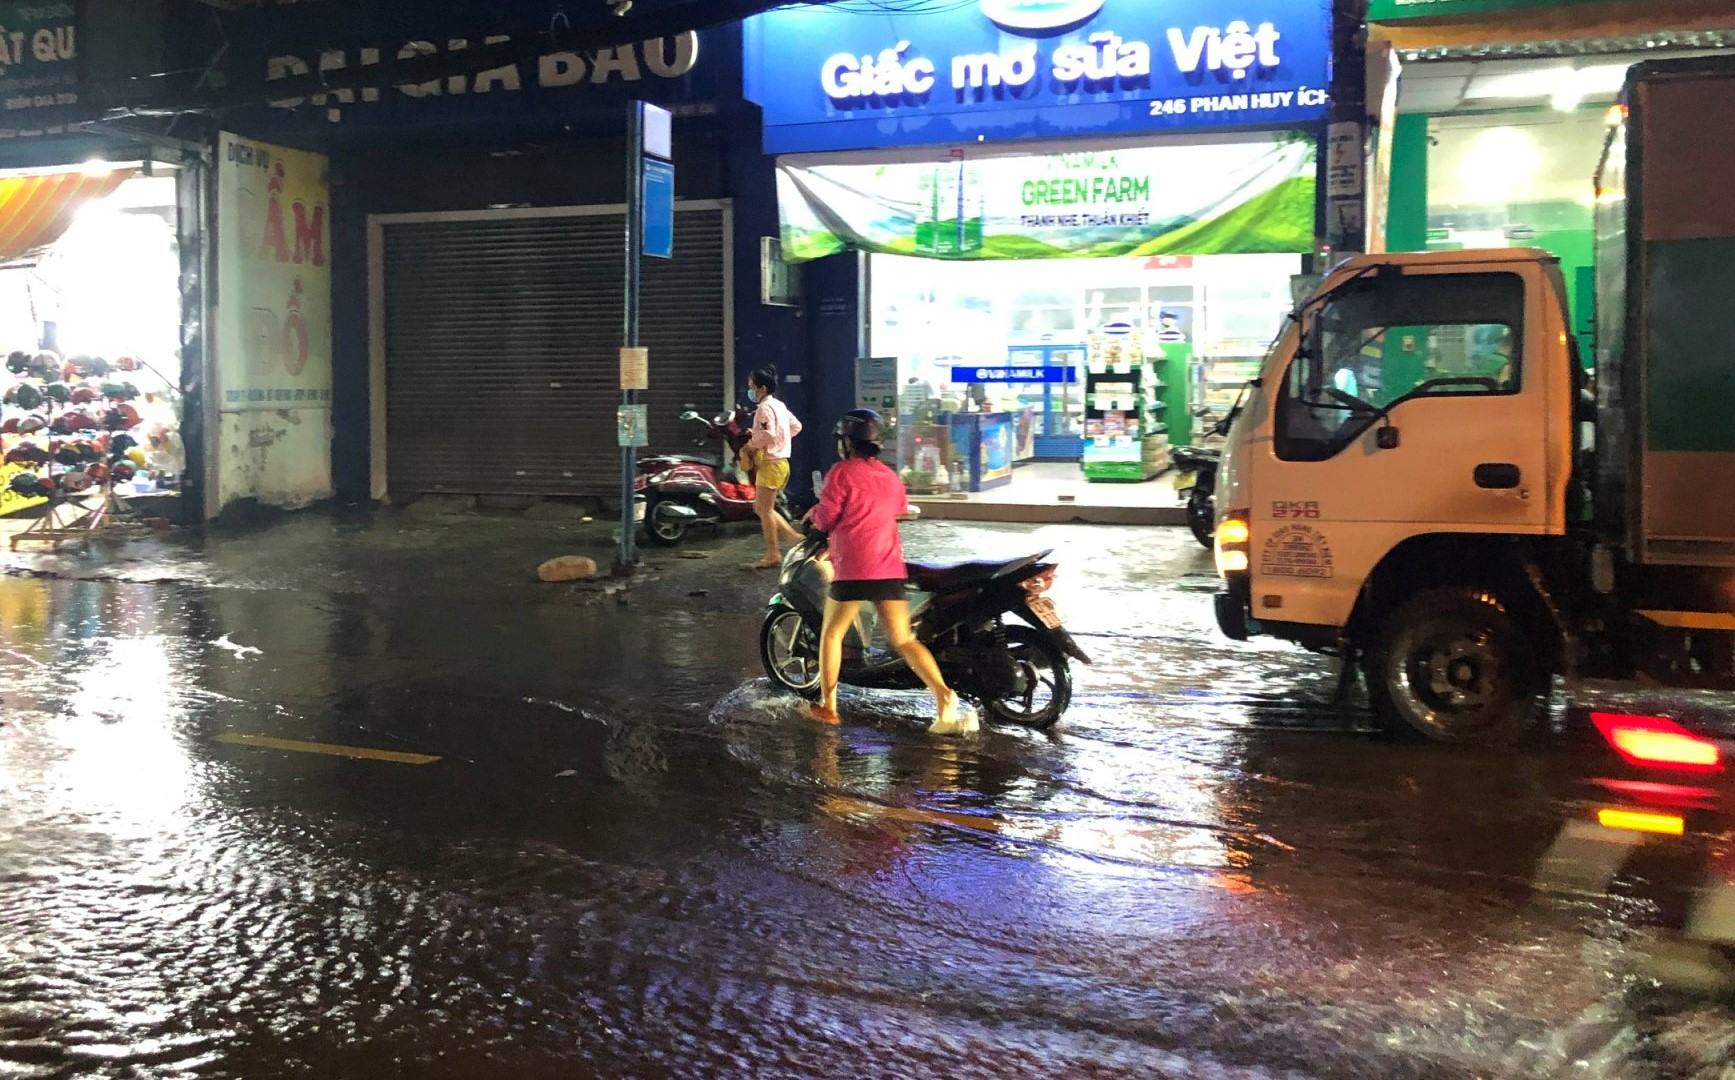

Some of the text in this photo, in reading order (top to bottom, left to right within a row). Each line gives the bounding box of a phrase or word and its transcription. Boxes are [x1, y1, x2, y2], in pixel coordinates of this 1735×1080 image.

[821, 20, 1280, 98] Giấc mơ sữa Việt
[1149, 98, 1187, 116] 246
[1190, 93, 1248, 113] PHAN
[1250, 90, 1293, 110] HUY
[1022, 175, 1150, 206] GREEN FARM
